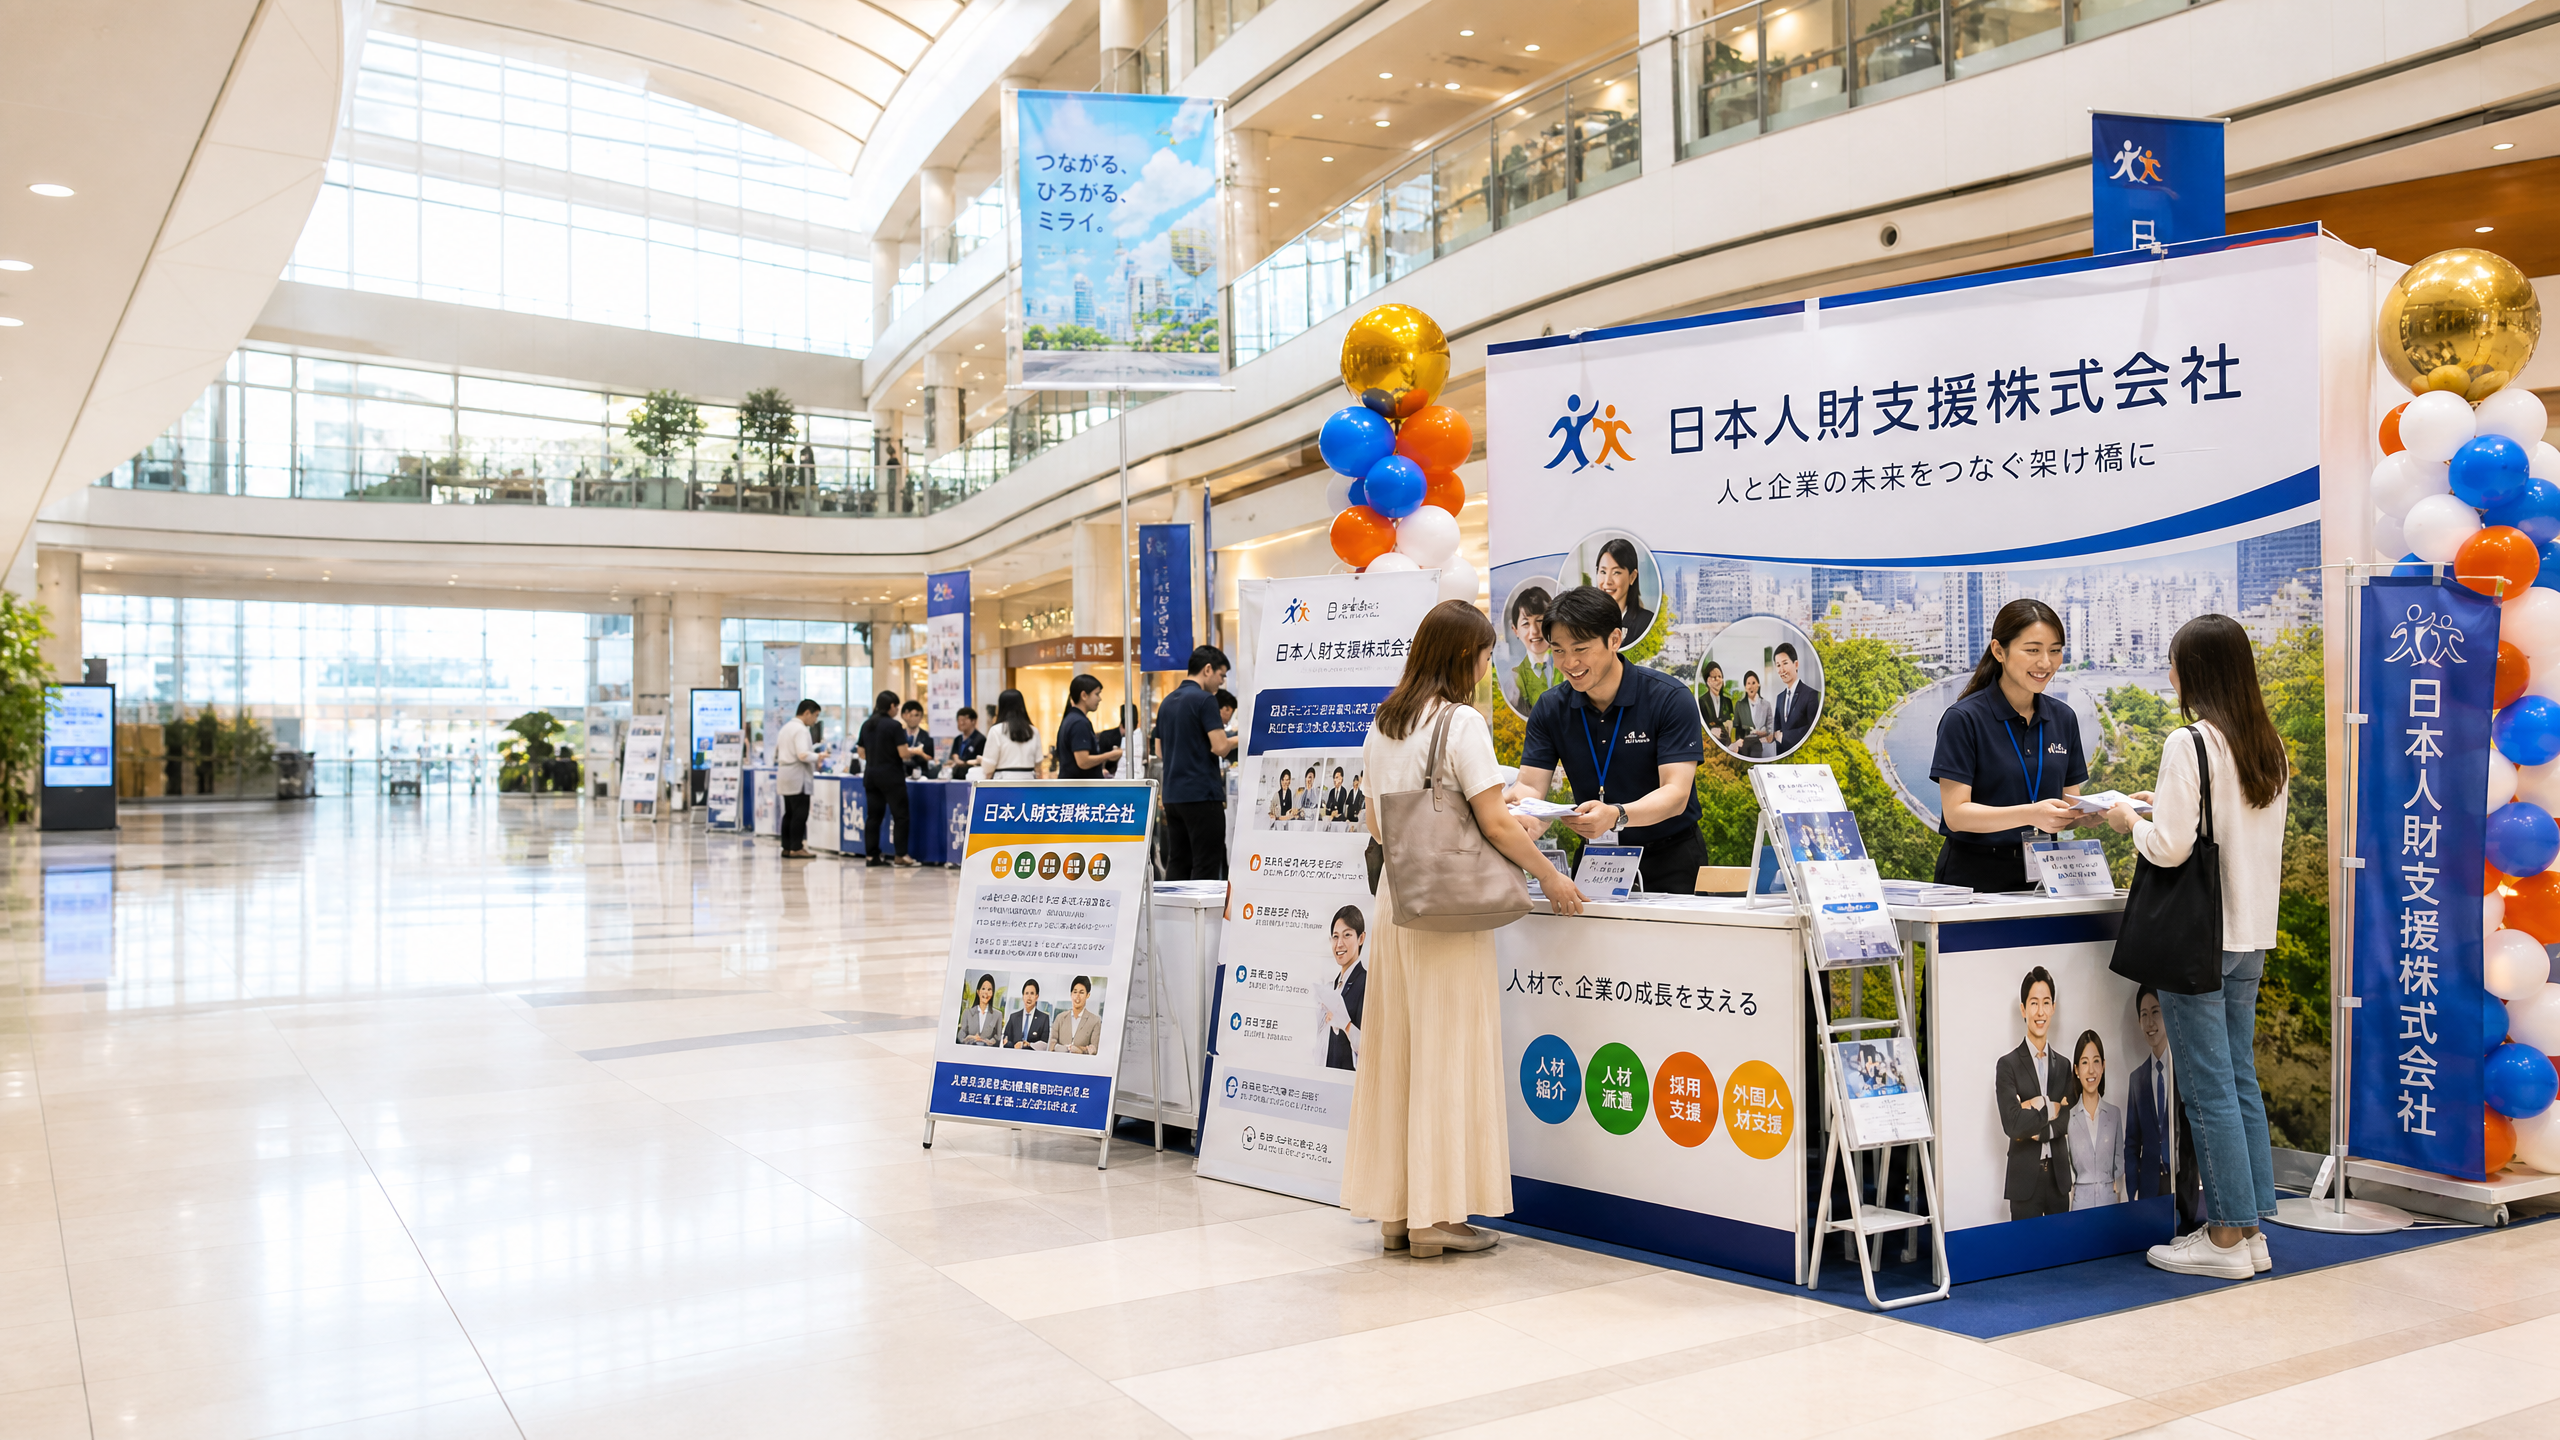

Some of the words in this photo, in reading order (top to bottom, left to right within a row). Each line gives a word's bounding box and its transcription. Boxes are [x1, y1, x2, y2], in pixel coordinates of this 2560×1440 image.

[1035, 153, 1127, 175] つながる、
[1037, 182, 1126, 204] ひろがる、
[1039, 210, 1104, 233] ミライ。
[1669, 342, 2243, 456] 日本人財支援株式会社
[1716, 440, 2157, 506] 人と企業の未来をつなぐ架け橋に
[984, 802, 1136, 824] 日本人財支援株式会社
[2396, 678, 2445, 1138] 日本人財支援株式会社
[1505, 968, 1758, 1017] 人材で、企業の成長を支える
[1535, 1056, 1566, 1078] 人材
[1601, 1065, 1632, 1087] 人材
[1669, 1074, 1701, 1099] 採用
[1669, 1099, 1702, 1123] 支援
